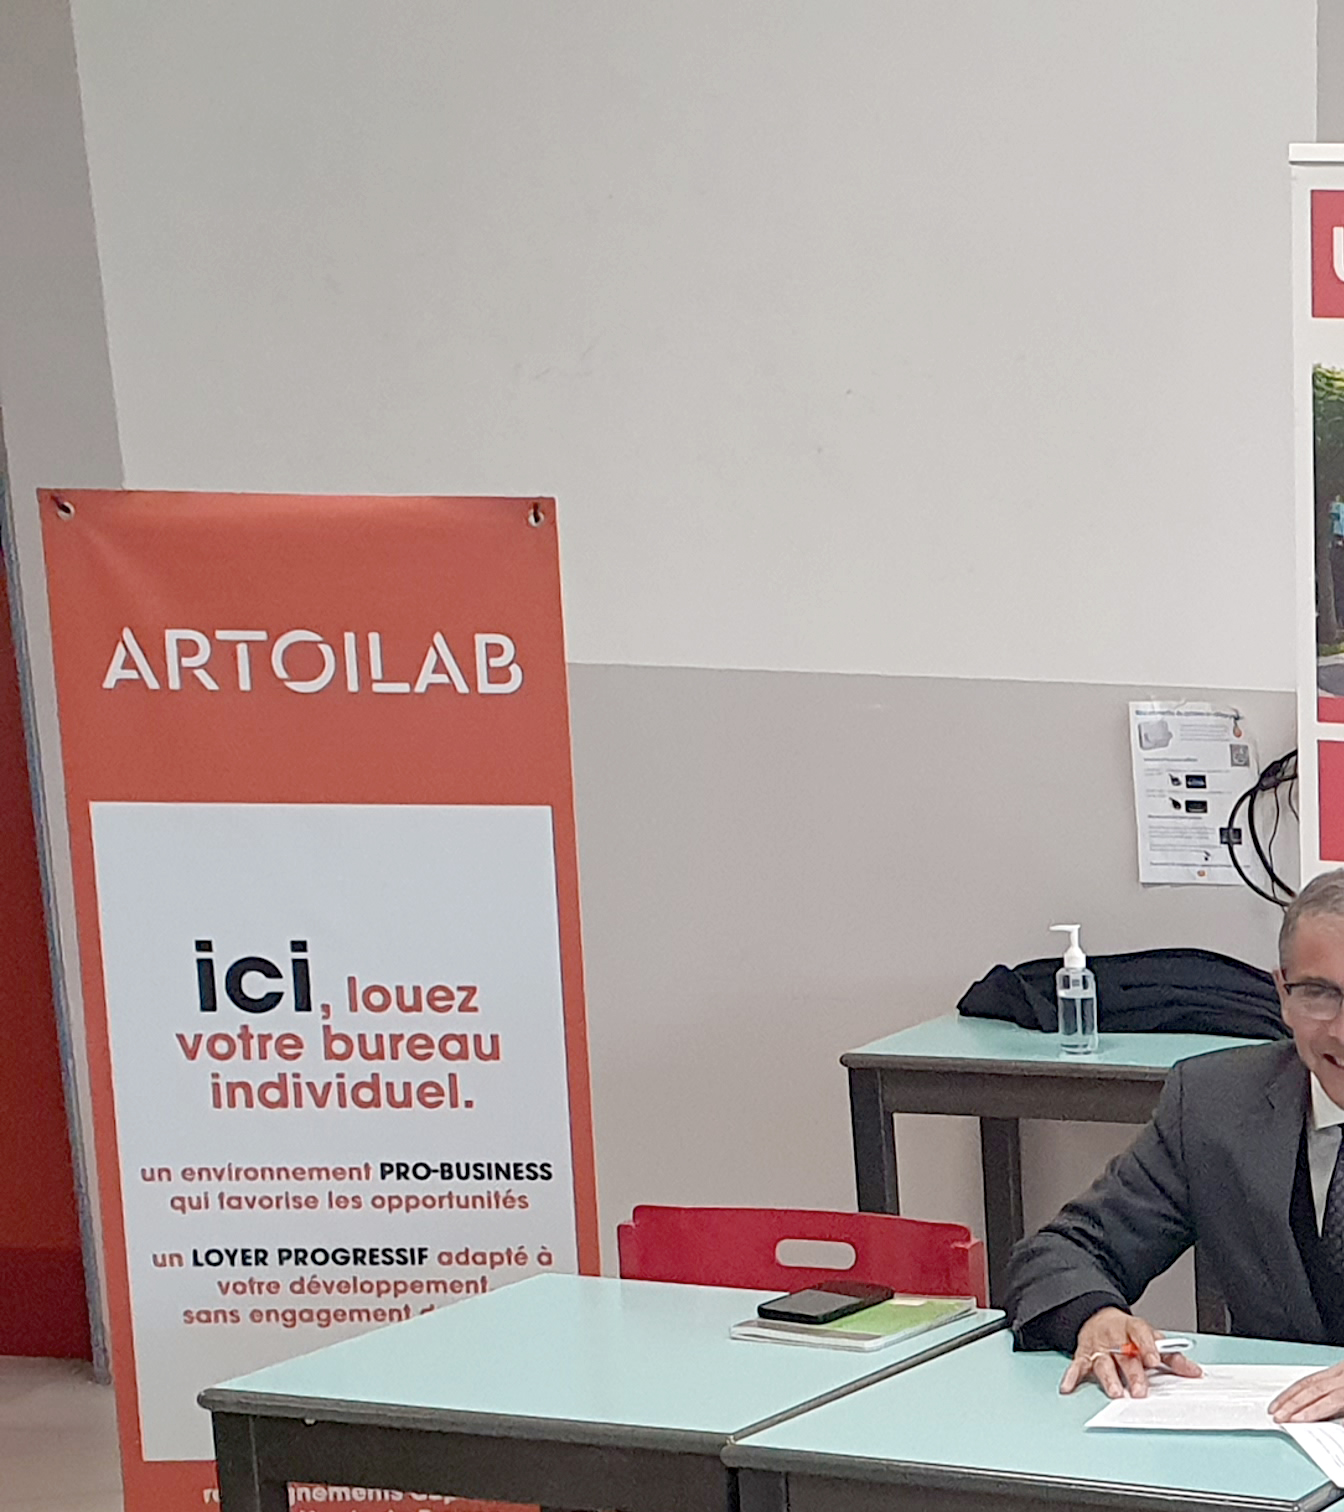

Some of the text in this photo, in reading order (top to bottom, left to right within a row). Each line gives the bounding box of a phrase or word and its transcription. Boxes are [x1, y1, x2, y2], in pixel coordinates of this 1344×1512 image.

[102, 626, 524, 694] ARTOILAB
[194, 940, 480, 1019] ici, louez
[176, 1024, 501, 1061] votre bureau
[211, 1072, 474, 1109] individuel.
[141, 1162, 553, 1182] un environnement PRO-BUSINESS
[170, 1188, 530, 1215] qui favorise les opportunités
[152, 1245, 553, 1270] un LOYER PROGRESSIF adapté à
[217, 1274, 488, 1298] votre développement
[183, 1308, 241, 1325] sans
[249, 1303, 411, 1329] engagement
